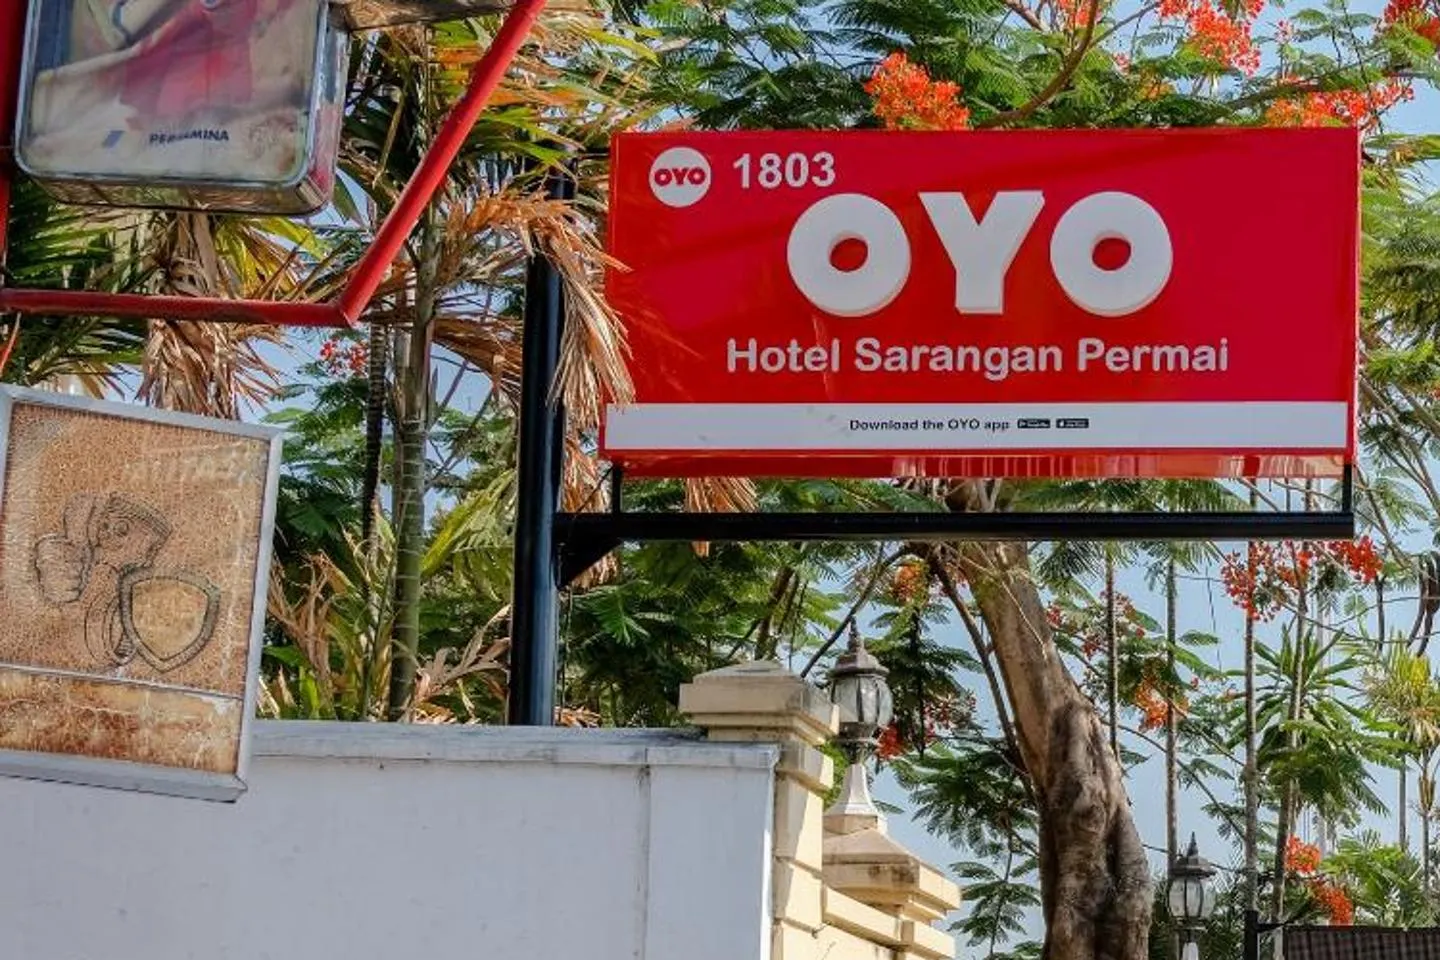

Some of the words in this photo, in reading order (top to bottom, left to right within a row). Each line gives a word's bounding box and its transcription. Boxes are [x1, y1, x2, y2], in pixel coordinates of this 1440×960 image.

[149, 129, 229, 144] PERMINA
[654, 167, 706, 187] OYO
[733, 151, 836, 189] 1803
[787, 190, 1173, 317] OYO
[727, 337, 840, 373] Hotel
[854, 337, 1063, 381] Sarangan
[1077, 337, 1229, 372] Permai
[849, 419, 918, 431] Download
[922, 418, 944, 431] the
[948, 418, 981, 431] OYO
[984, 421, 1010, 433] app
